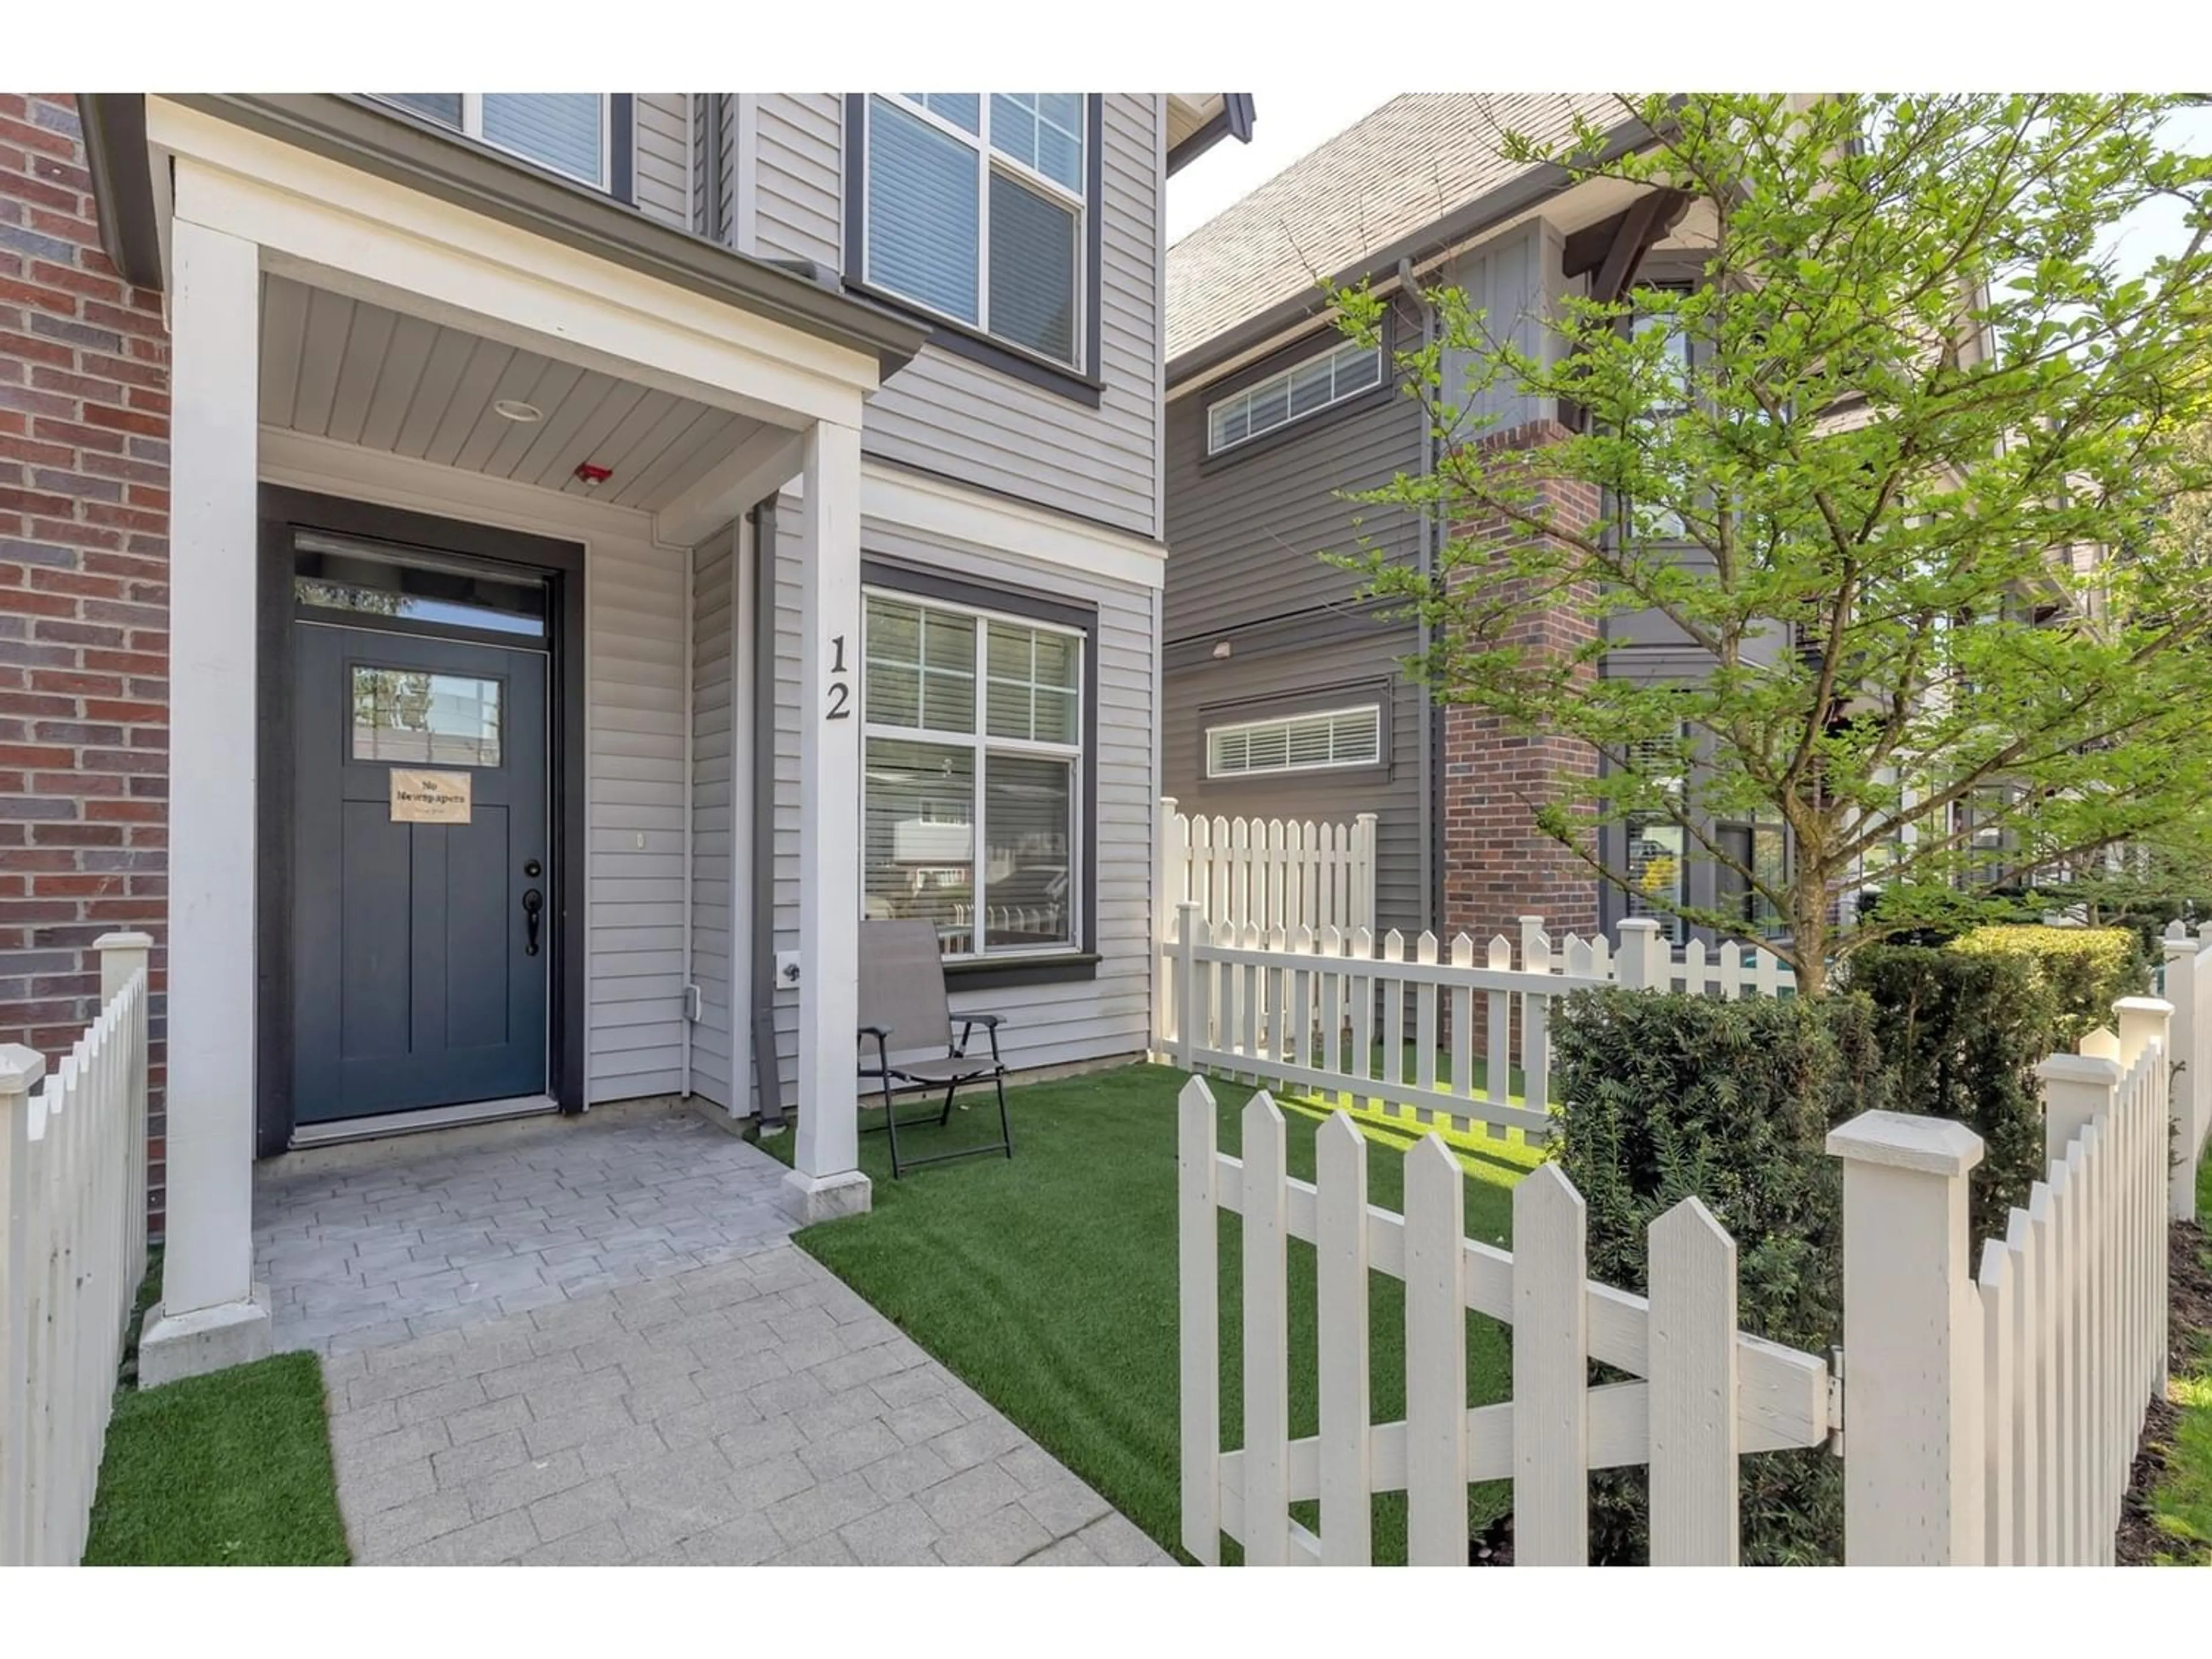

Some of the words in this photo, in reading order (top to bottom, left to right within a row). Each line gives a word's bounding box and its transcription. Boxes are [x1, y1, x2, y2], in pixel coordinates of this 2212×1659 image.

[826, 635, 850, 720] 12
[422, 781, 438, 791] No
[396, 790, 465, 804] Newspapers
